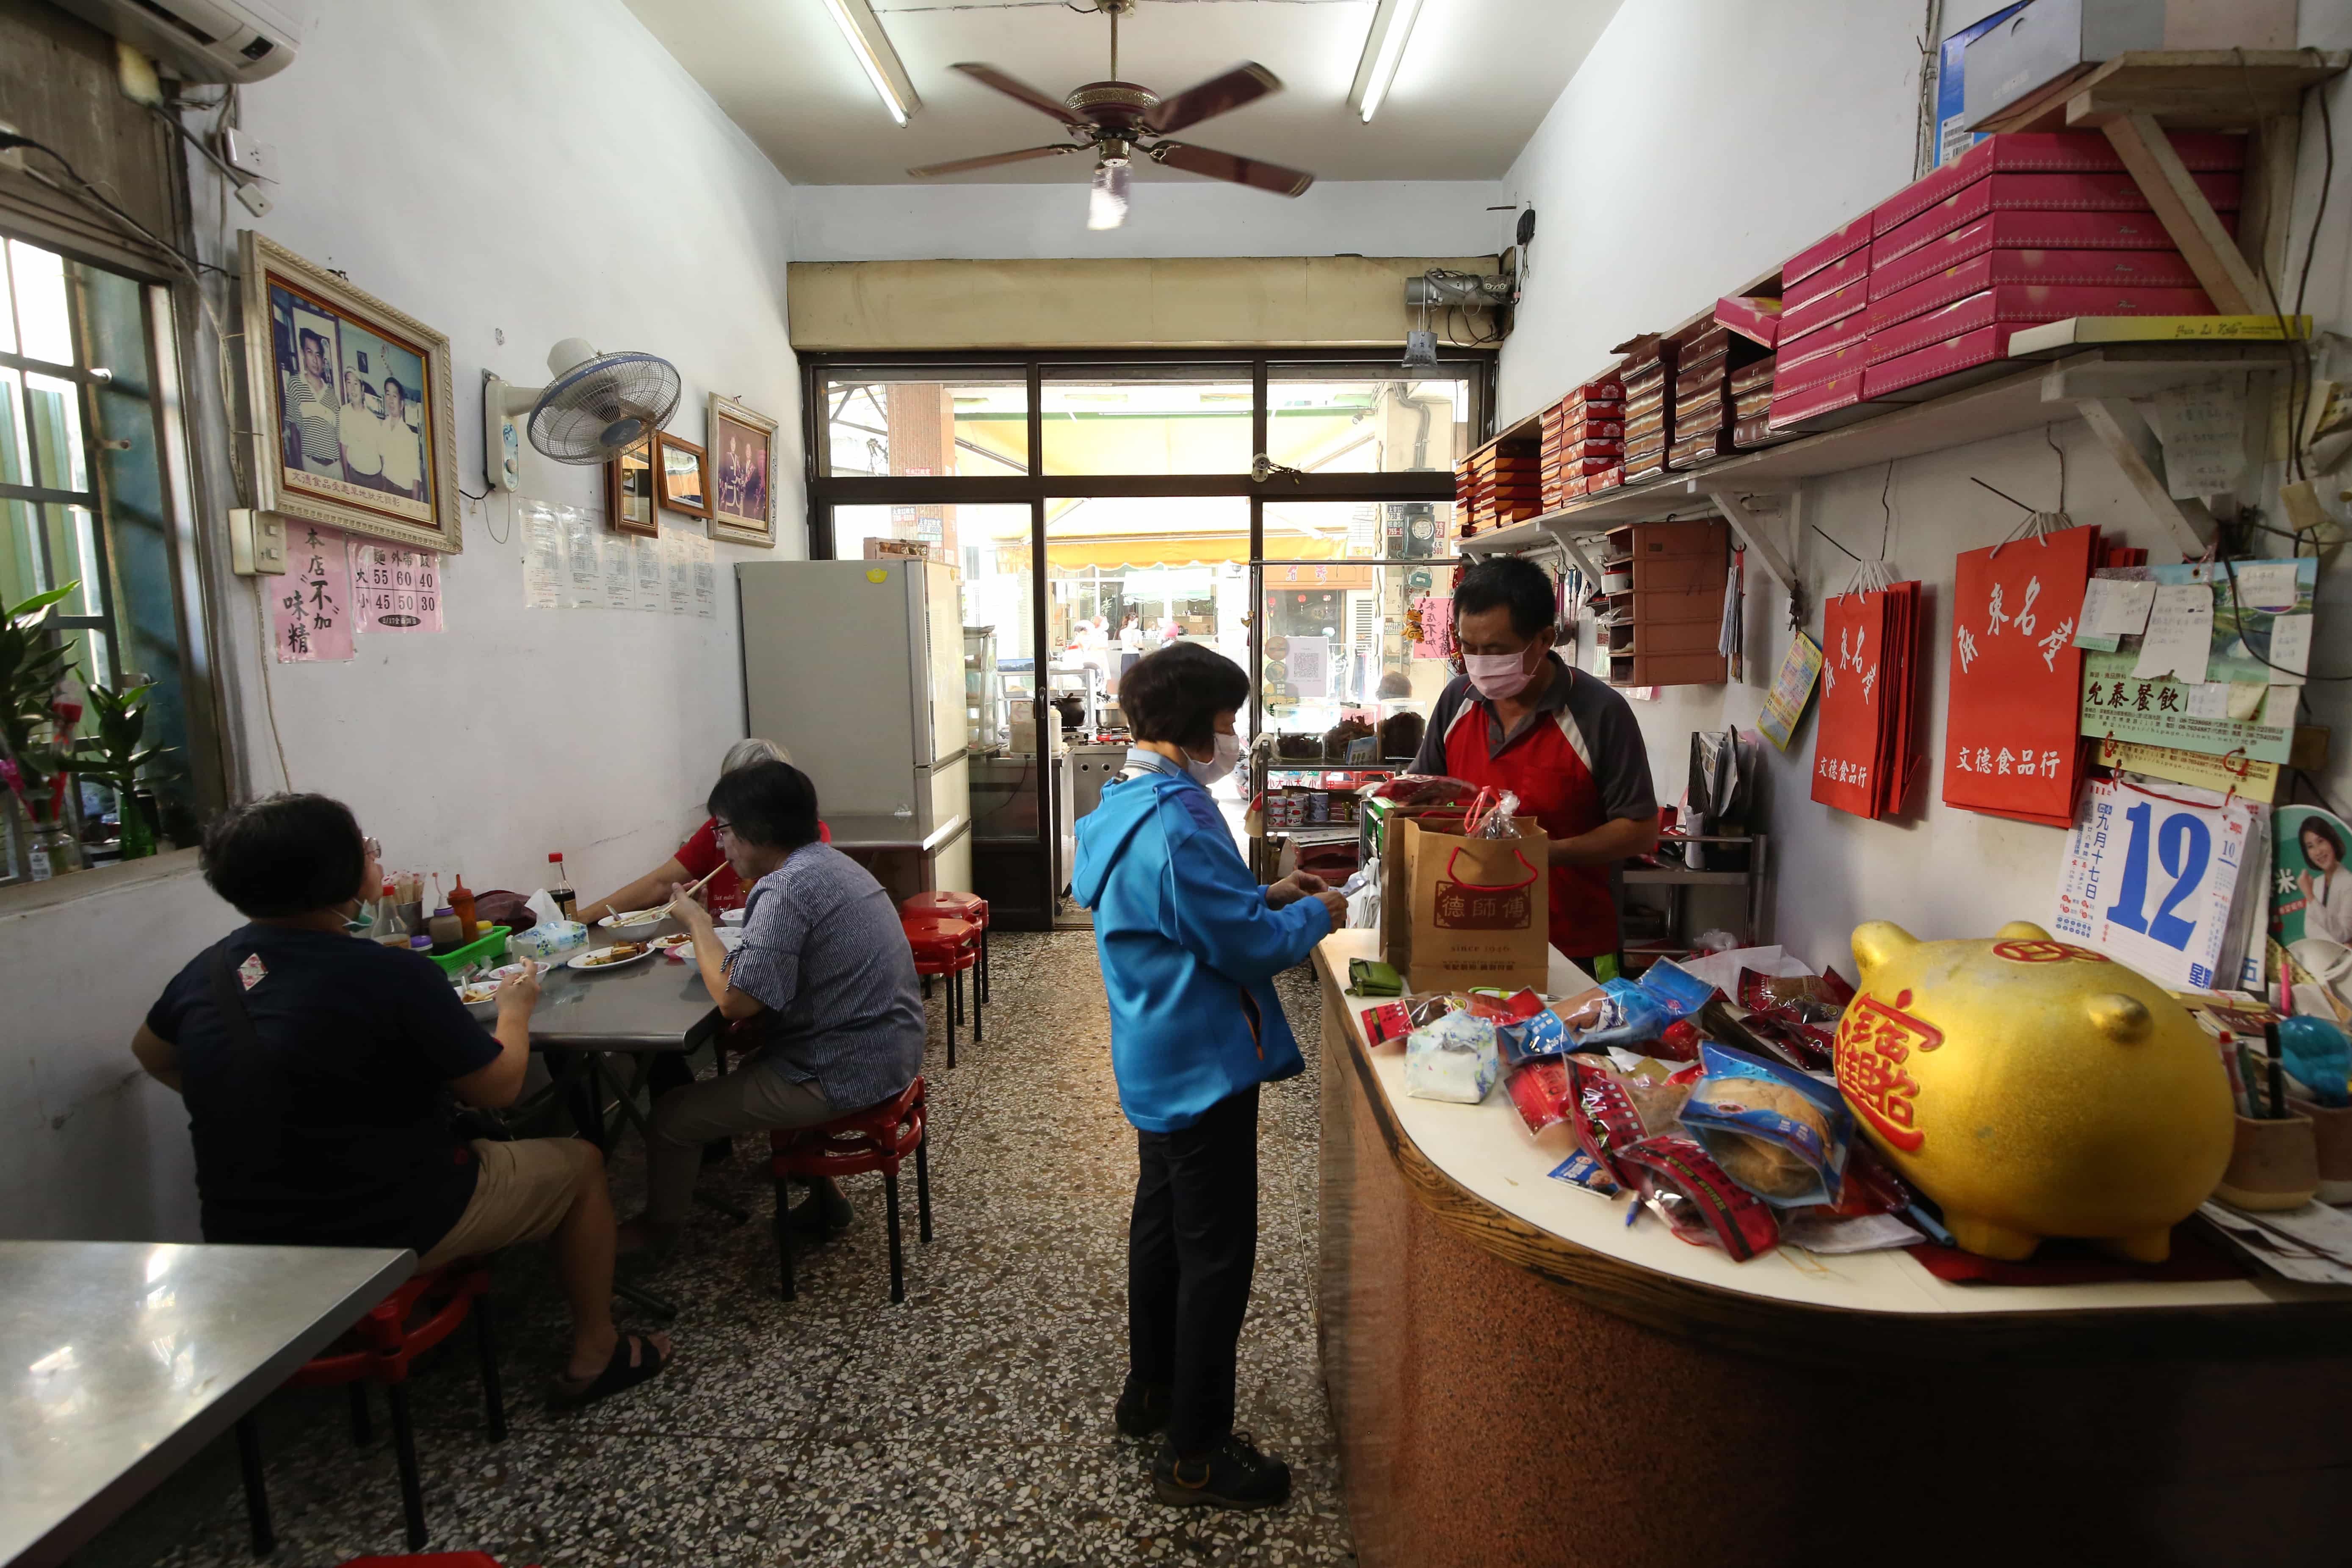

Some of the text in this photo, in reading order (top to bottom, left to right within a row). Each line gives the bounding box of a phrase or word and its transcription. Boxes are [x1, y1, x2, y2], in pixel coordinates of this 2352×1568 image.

[356, 569, 433, 588] 大 55 60 40
[358, 593, 435, 611] 小 45 50 30
[282, 590, 310, 654] 味精
[2086, 680, 2180, 713] 允泰餐飲
[1818, 756, 1868, 789] 文德食品行
[1956, 747, 2061, 780] 文德食品行
[2086, 813, 2109, 900] 九月十七日
[2222, 840, 2236, 858] 10
[2106, 801, 2211, 952] 12
[1442, 895, 1525, 918] 德師傅
